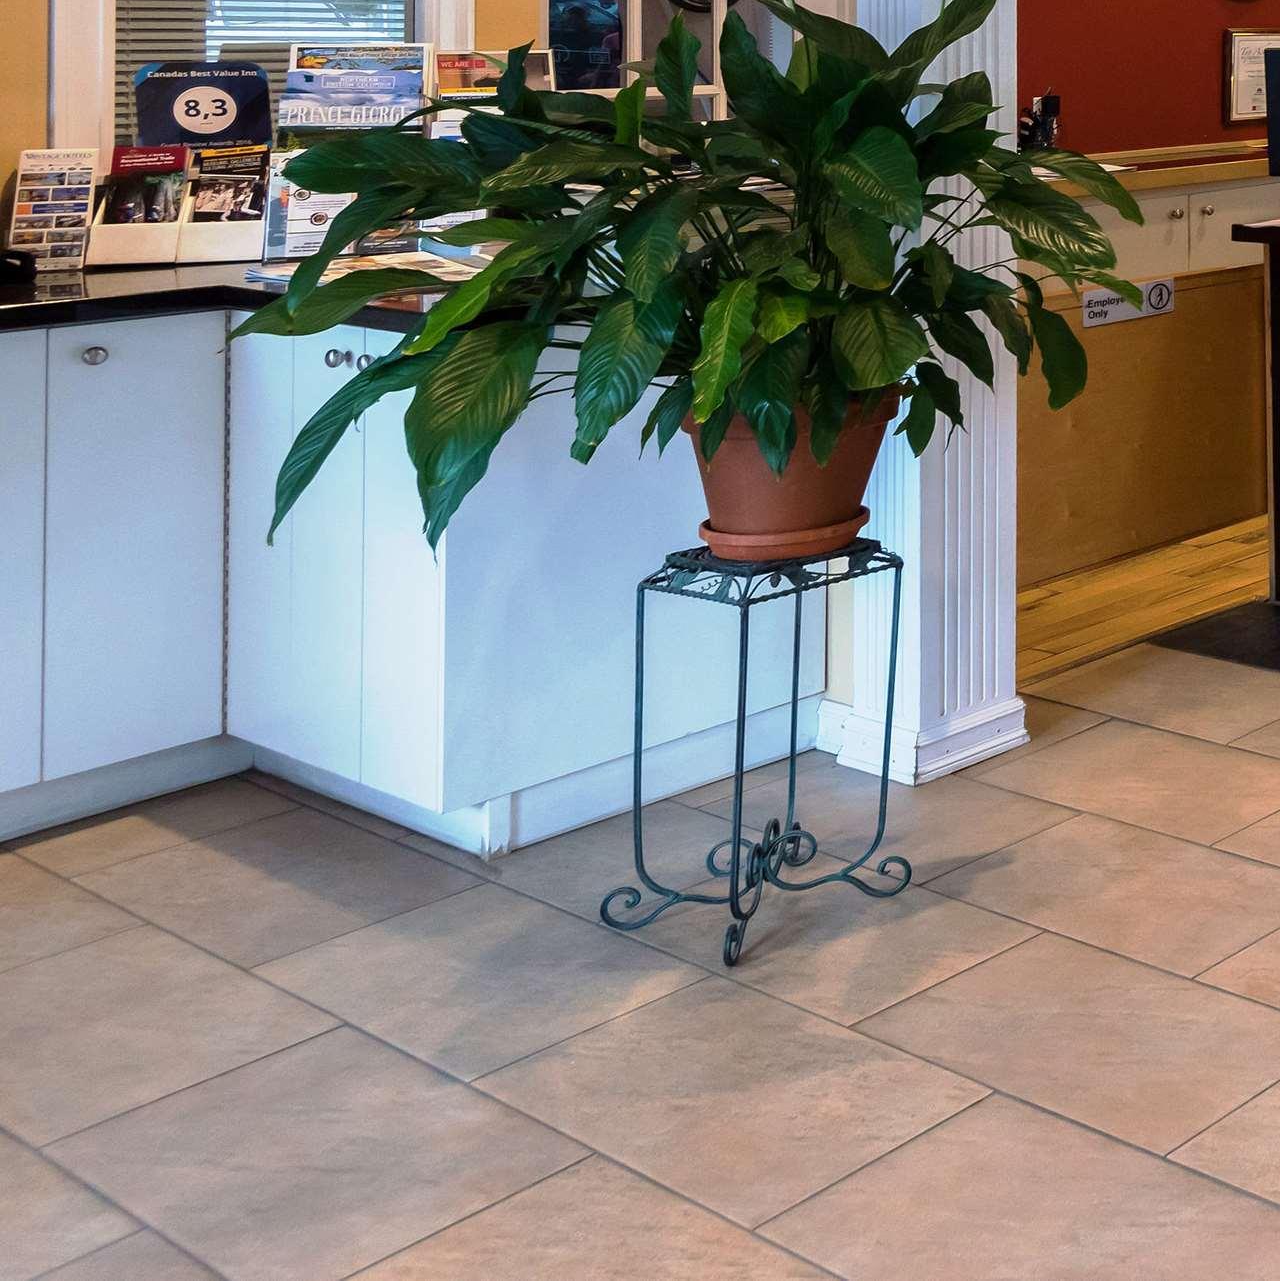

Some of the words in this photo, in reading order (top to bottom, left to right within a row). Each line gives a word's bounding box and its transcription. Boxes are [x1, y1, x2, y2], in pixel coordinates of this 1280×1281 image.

[184, 99, 228, 119] 8,3
[286, 106, 344, 125] PRINCE
[1087, 296, 1124, 309] Employe
[1087, 309, 1109, 319] Only
